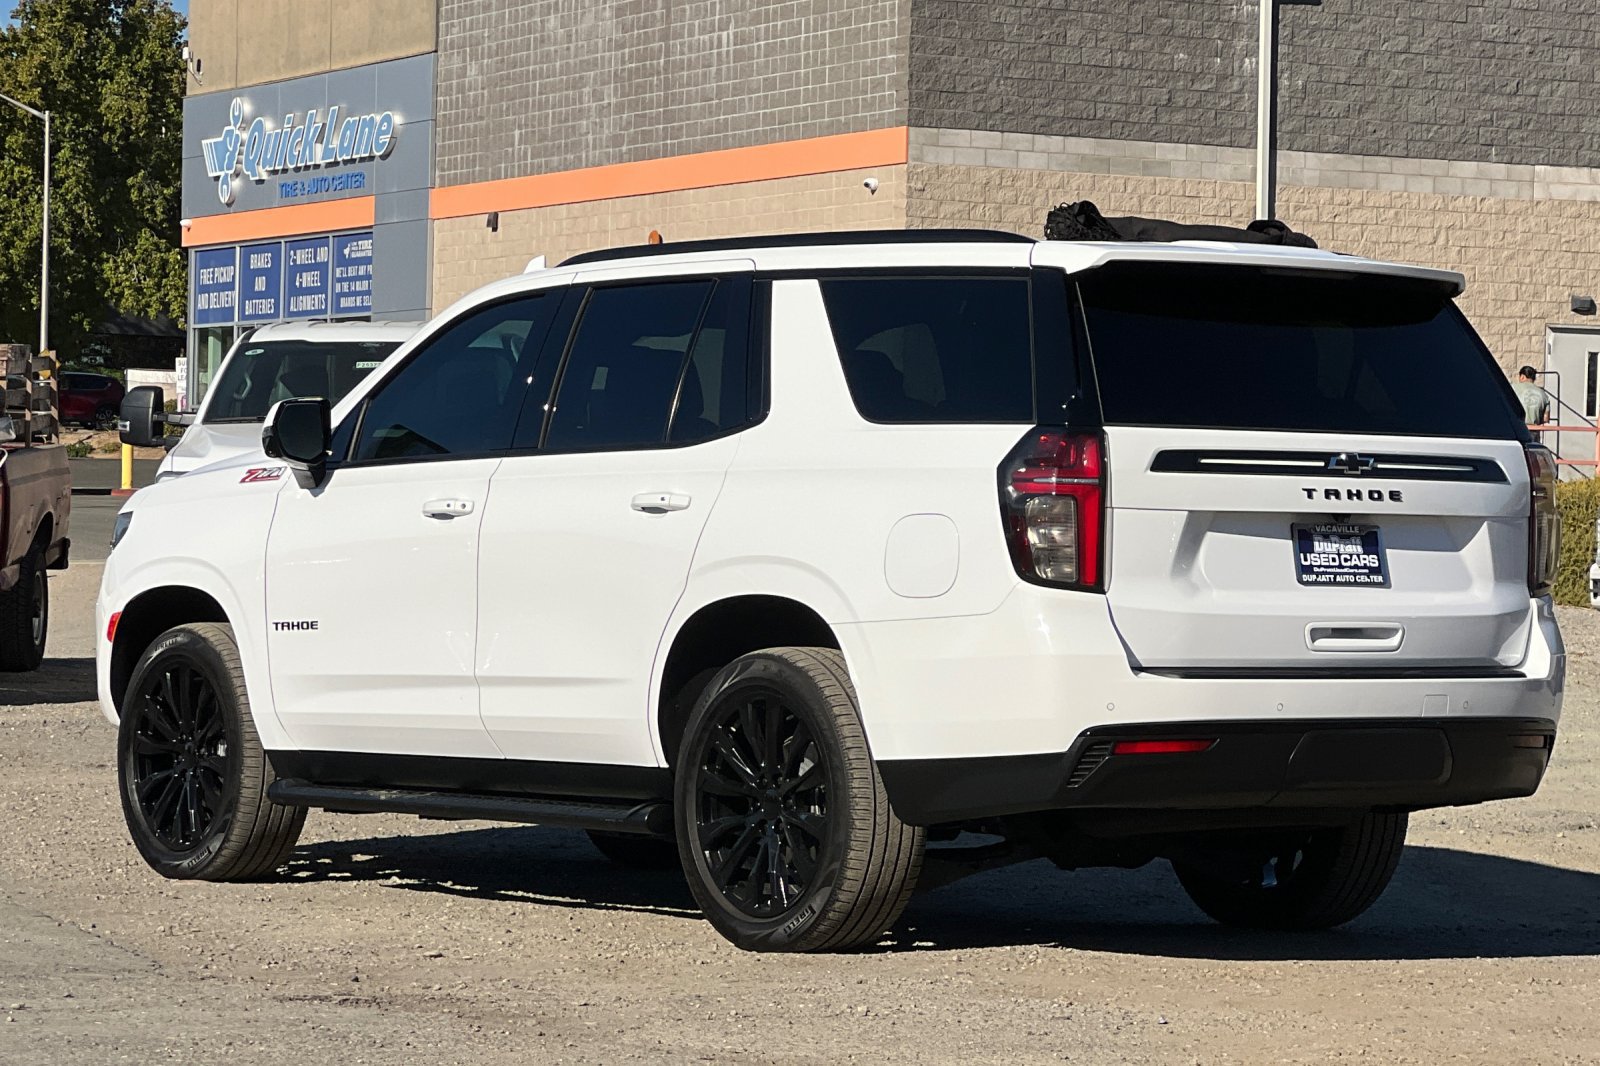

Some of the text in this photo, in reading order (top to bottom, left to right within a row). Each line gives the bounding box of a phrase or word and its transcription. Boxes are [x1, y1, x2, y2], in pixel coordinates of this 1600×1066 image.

[243, 106, 394, 181] Quick Lane
[279, 172, 366, 199] TIRE & AUTO CENTER
[250, 253, 272, 270] BRAKES
[289, 246, 329, 266] 2-WHEEL AND
[200, 266, 235, 286] FREE PICKUP
[358, 265, 367, 276] ANY
[254, 276, 266, 292] AND
[295, 271, 321, 288] 4-WHEEL
[341, 281, 349, 292] THE
[197, 290, 236, 310] AND DELIVERY
[245, 299, 275, 316] BATTERIES
[289, 294, 326, 312] ALIGNMENTS
[356, 296, 363, 307] WE
[1301, 487, 1404, 502] TAHOE
[1315, 524, 1360, 533] VACAVILLE
[1313, 534, 1363, 554] DuPratt
[1300, 553, 1379, 567] USED CARS
[1355, 575, 1384, 583] CENTER
[272, 620, 319, 632] TAHOE
[783, 904, 817, 936] PIRELLI
